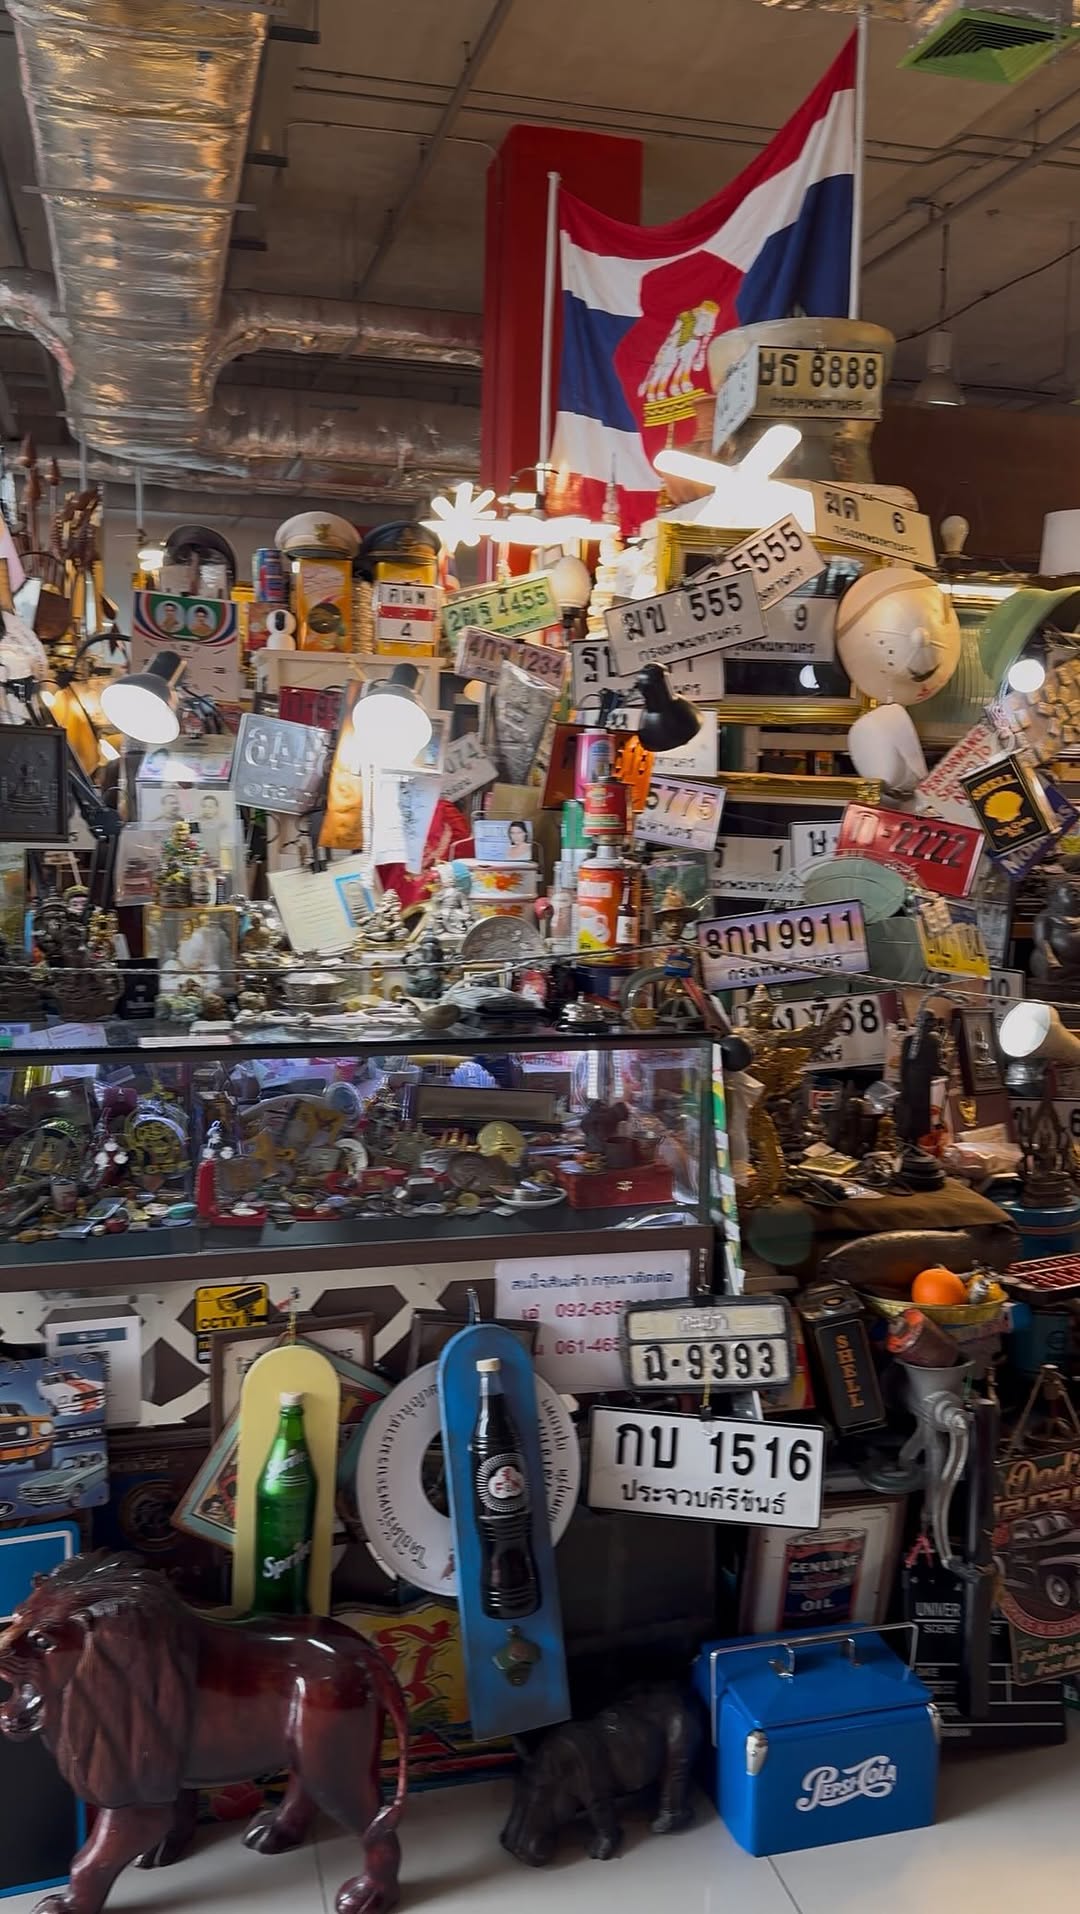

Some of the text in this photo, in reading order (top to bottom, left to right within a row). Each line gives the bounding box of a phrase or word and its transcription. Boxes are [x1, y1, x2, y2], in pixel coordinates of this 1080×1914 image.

[811, 355, 877, 390] 8888
[892, 511, 906, 535] 6
[688, 582, 743, 622] 555
[794, 603, 808, 631] 9
[780, 910, 857, 950] 9911
[200, 1315, 242, 1330] CCTV
[834, 1333, 865, 1409] SHELL
[615, 1422, 812, 1481] กบ 1516
[622, 1478, 787, 1516] ประจวบคีรีขันธ์
[788, 1554, 859, 1573] GENUINE
[801, 1598, 834, 1612] OIL
[915, 1602, 961, 1617] UNIVER
[923, 1624, 959, 1634] SCENE
